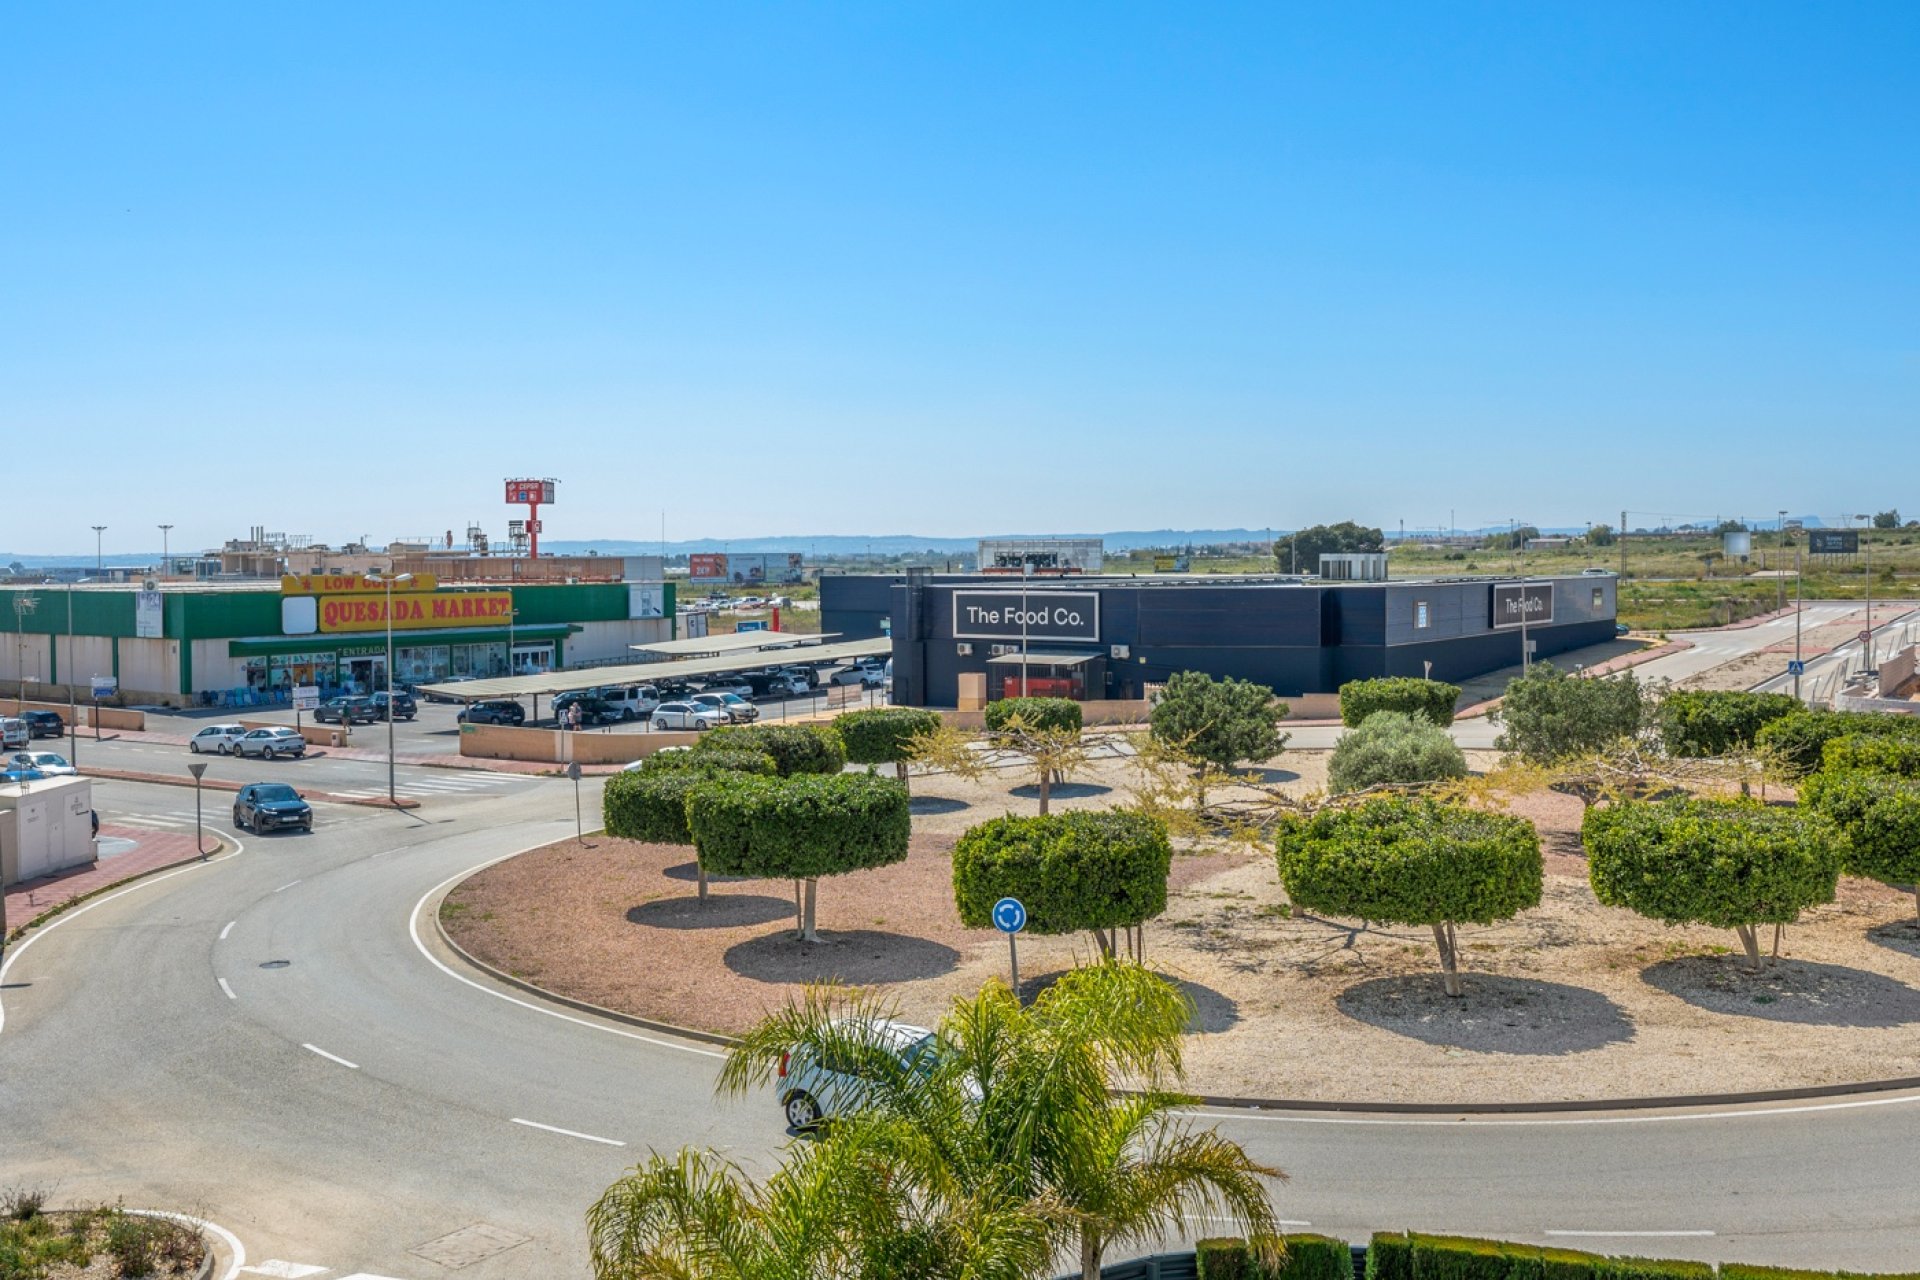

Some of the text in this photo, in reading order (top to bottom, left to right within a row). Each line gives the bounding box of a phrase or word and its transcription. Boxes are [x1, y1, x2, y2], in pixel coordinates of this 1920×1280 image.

[324, 577, 355, 590] LOW
[324, 597, 510, 627] QUESADA MARKET
[1517, 596, 1533, 613] Fod
[966, 606, 1084, 626] The Food Co.
